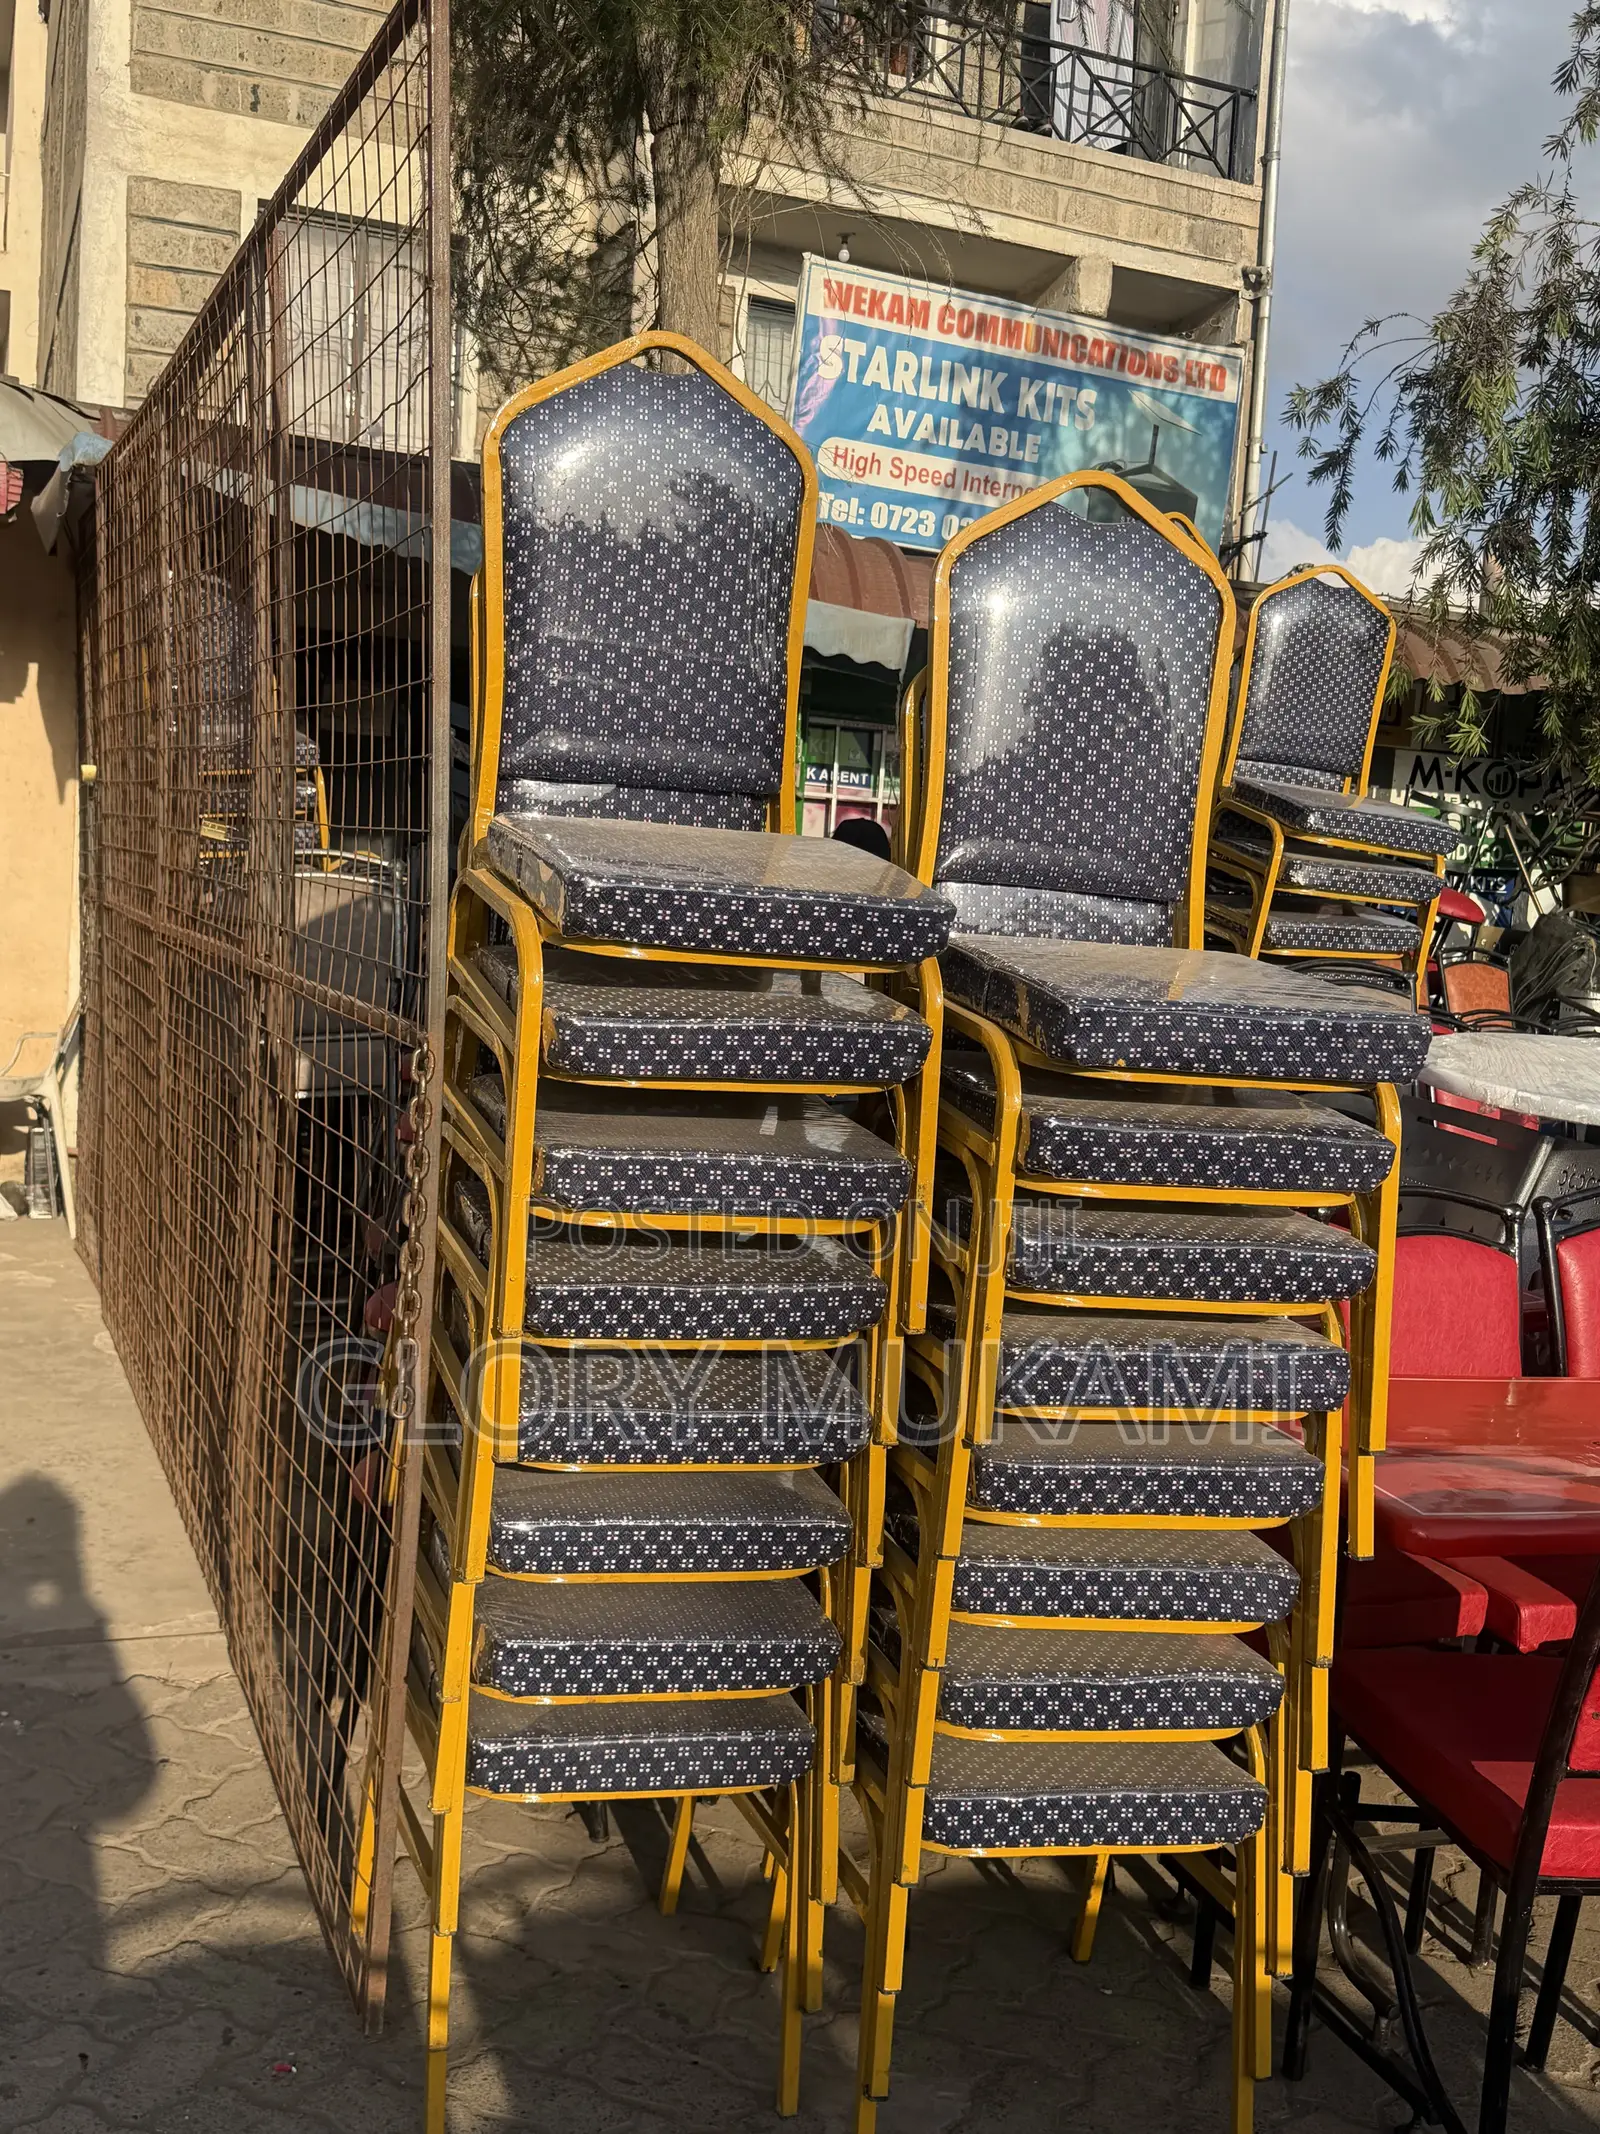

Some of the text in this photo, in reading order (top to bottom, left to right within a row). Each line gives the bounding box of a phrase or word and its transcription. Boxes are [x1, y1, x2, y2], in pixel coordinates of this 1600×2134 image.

[823, 278, 1227, 393] WEKAM COMMUNICATIONS LTD
[817, 334, 1098, 431] STARLINK KITS
[866, 404, 1041, 464] AVAILABLE
[832, 445, 882, 479] High
[889, 456, 957, 487] Speed
[818, 491, 866, 526] Tel:
[870, 501, 936, 537] 0723
